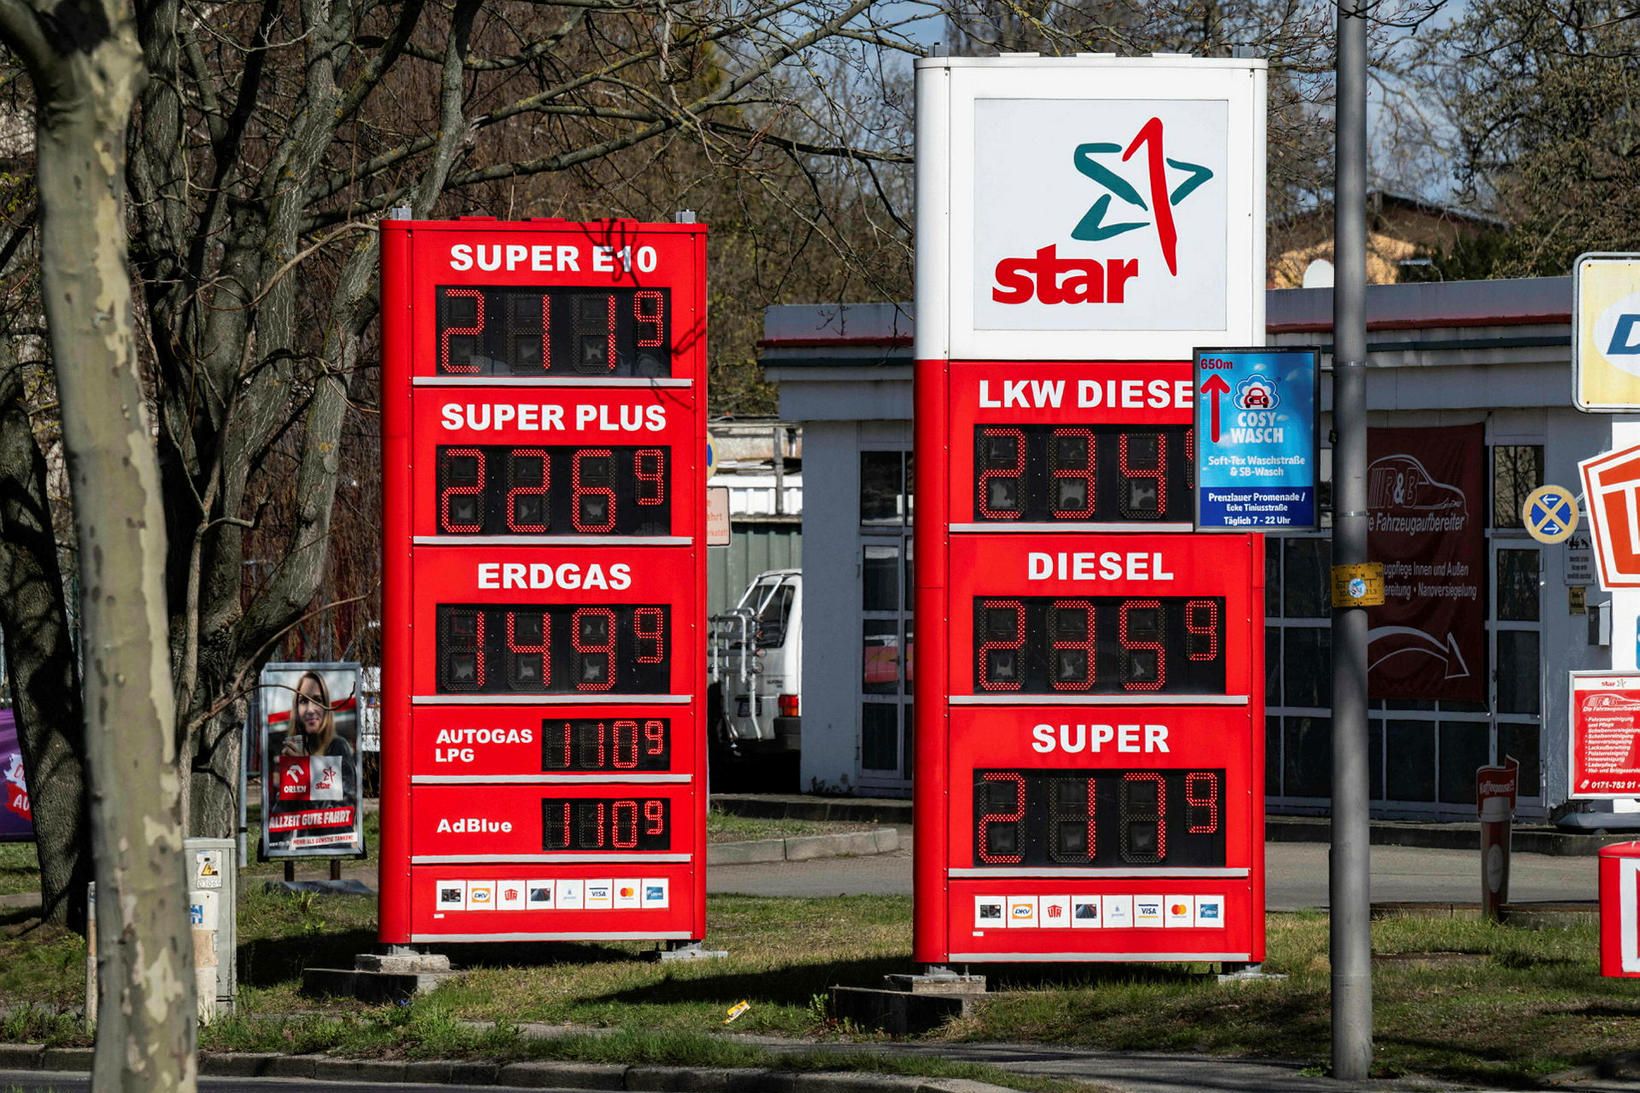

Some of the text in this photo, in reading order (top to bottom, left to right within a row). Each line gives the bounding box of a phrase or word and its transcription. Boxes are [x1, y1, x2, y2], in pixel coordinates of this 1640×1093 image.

[450, 244, 657, 273] SUPER E10
[992, 243, 1138, 305] star
[441, 289, 665, 373] 2119
[1200, 358, 1233, 370] 650m
[979, 379, 1194, 409] LKW DIESE
[440, 403, 667, 431] SUPER PLUS
[1230, 428, 1284, 444] WASCH
[1208, 455, 1305, 466] Soft-Tex Waschstraße
[1229, 466, 1284, 476] & SB-Wasch
[979, 428, 1194, 519] 234
[441, 448, 665, 533] 2269
[1208, 492, 1306, 502] Prenzlauer Promenade /
[1226, 503, 1288, 512] Ecke Tiniusstraße
[1224, 516, 1251, 526] Täglich
[1252, 516, 1258, 524] 7
[1265, 516, 1275, 524] 22
[1276, 516, 1291, 525] Uhr
[1375, 512, 1466, 536] Fahrzeugaufbereiter
[478, 562, 632, 590] ERDGAS
[1027, 551, 1174, 581] DIESEL
[1384, 560, 1469, 579] ugpflege Innen und Außen
[1384, 584, 1412, 601] ereitung
[1418, 583, 1477, 601] Nanoversiegelung
[475, 607, 664, 692] 1499
[979, 600, 1217, 691] 2359
[435, 728, 533, 745] AUTOGAS
[563, 720, 664, 769] 1109
[1031, 723, 1170, 753] SUPER
[435, 748, 475, 763] LPG
[284, 782, 331, 794] ORLEN star
[269, 810, 351, 829] ALLZEIT GUTE FAHRT
[436, 818, 513, 833] AdBlue
[563, 800, 664, 849] 1109
[978, 772, 1218, 864] 2179
[1141, 907, 1157, 915] VISA
